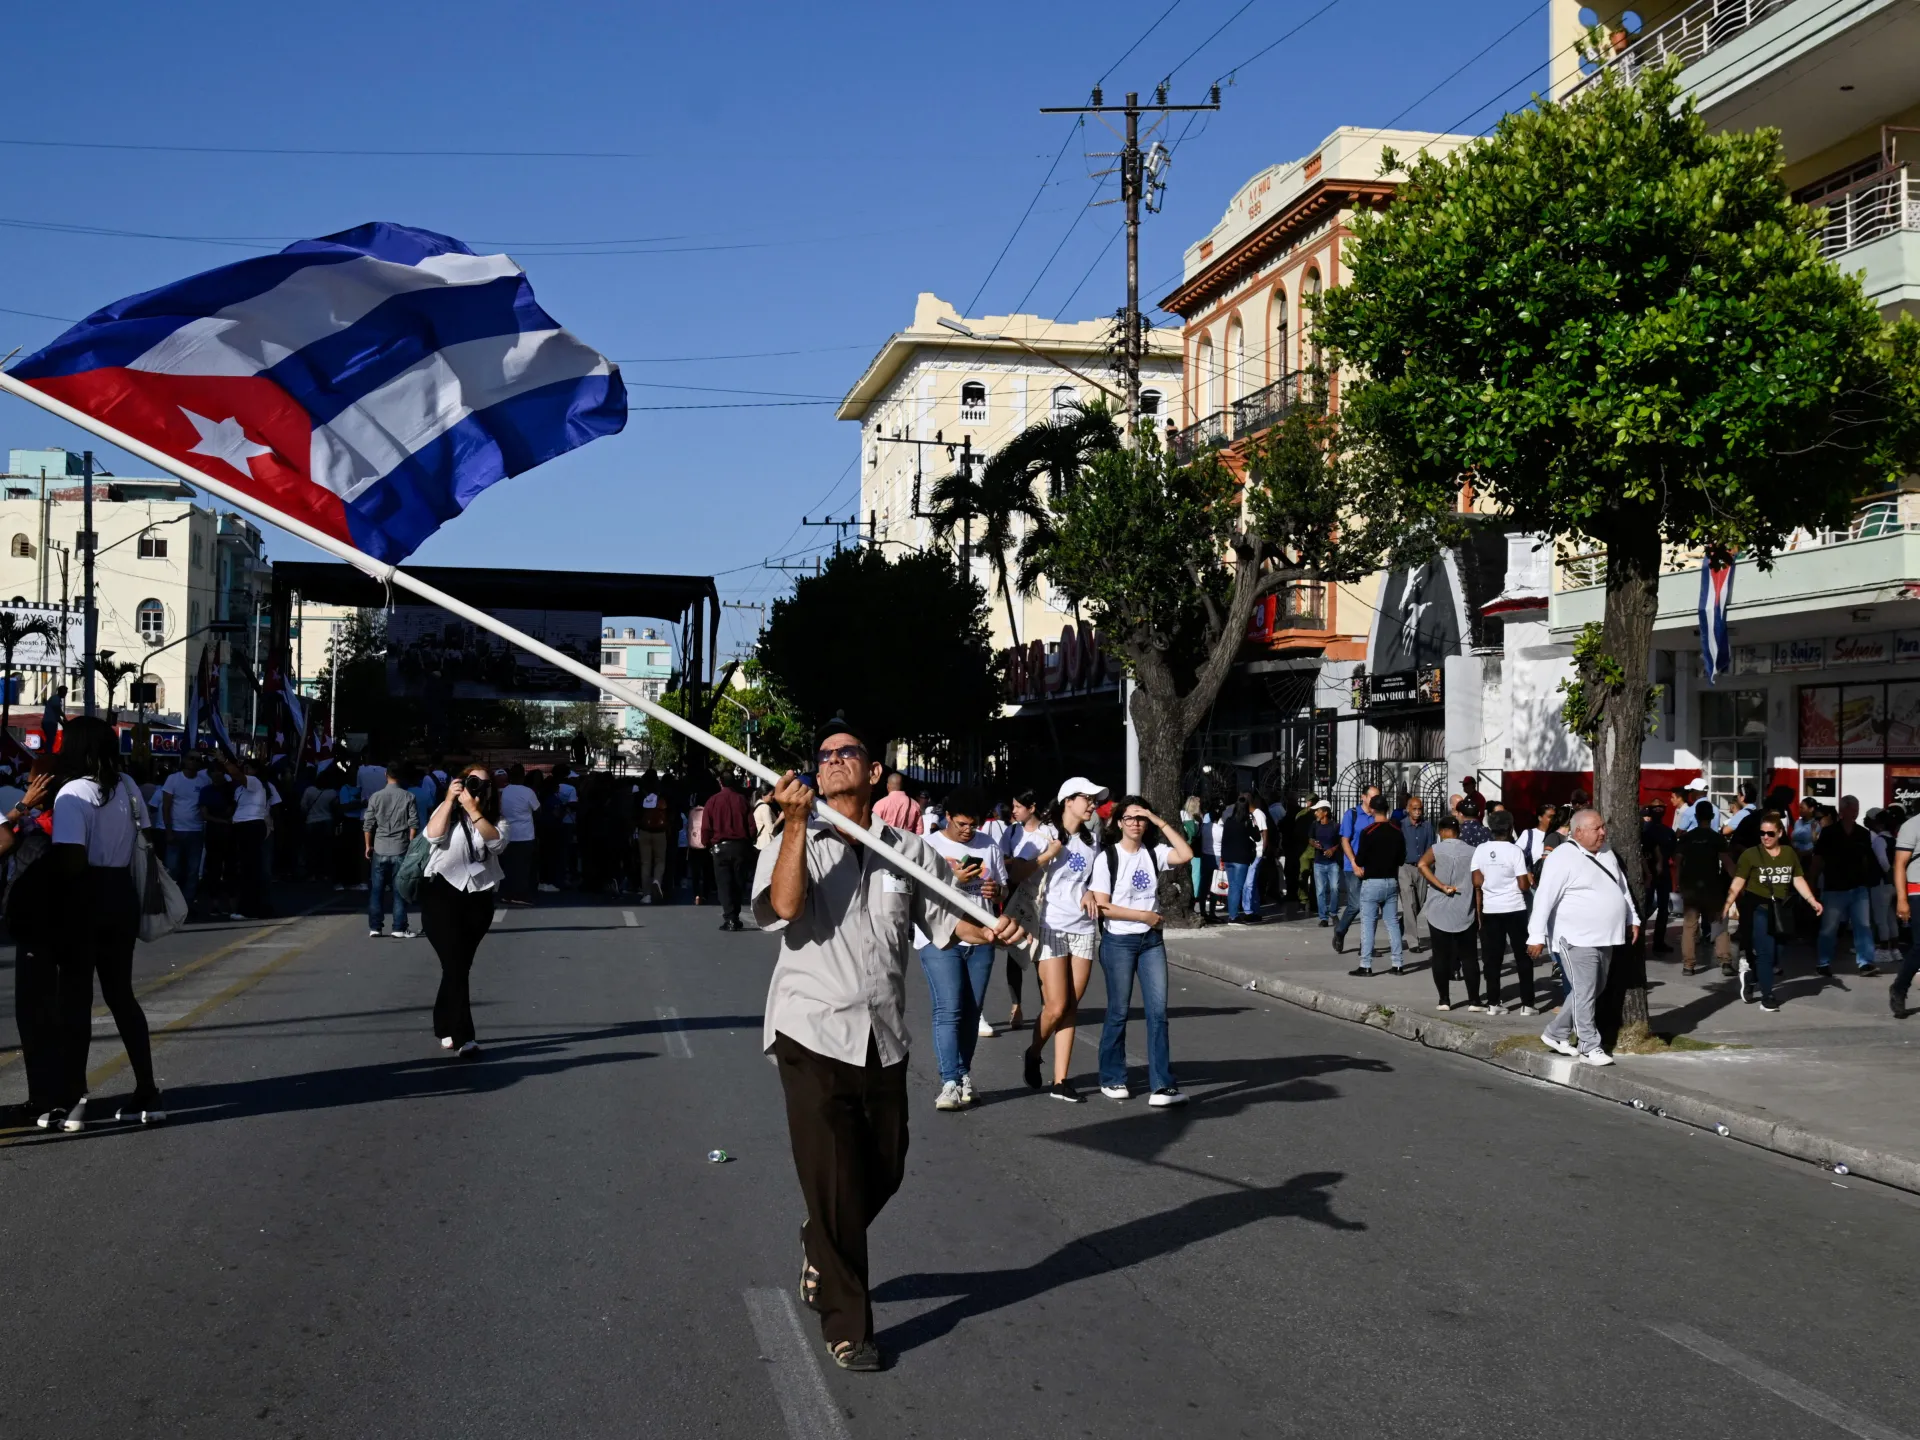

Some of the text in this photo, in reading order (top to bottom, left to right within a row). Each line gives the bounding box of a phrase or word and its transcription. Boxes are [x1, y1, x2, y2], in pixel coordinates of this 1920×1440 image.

[1389, 690, 1417, 701] CHOCOATE
[1758, 865, 1792, 875] YO SOY
